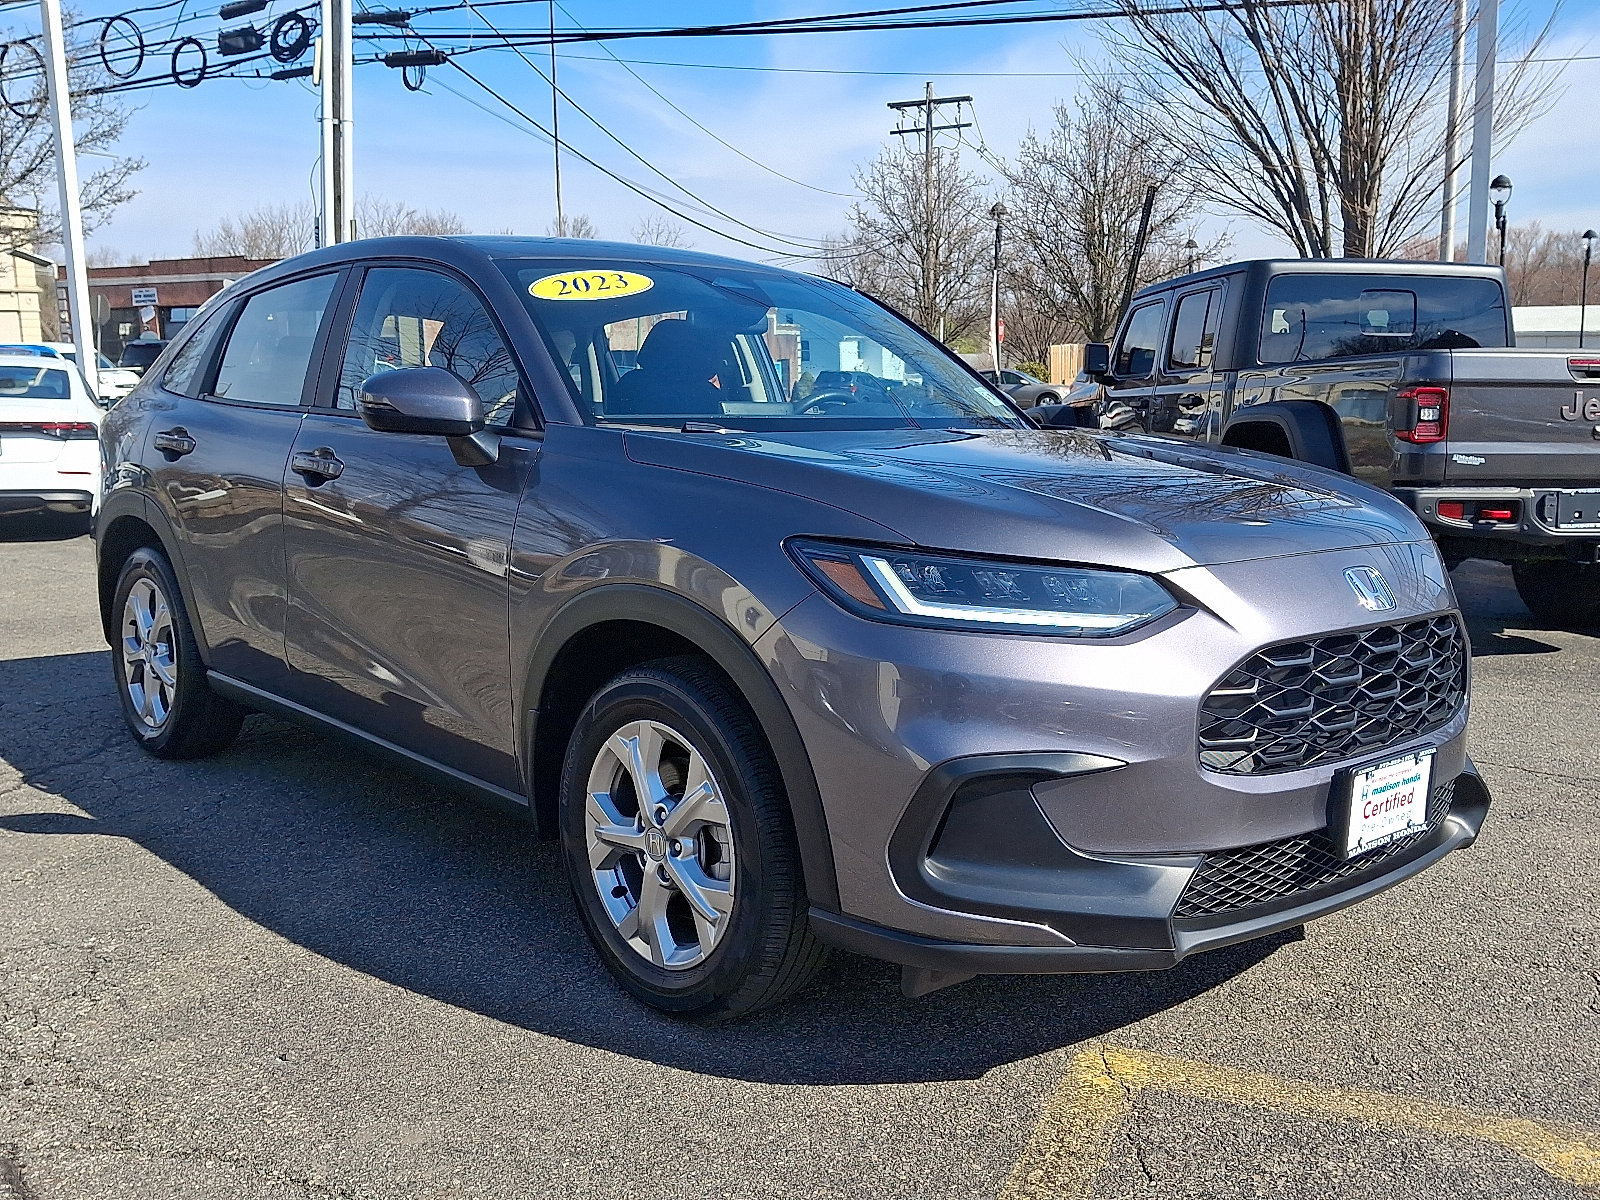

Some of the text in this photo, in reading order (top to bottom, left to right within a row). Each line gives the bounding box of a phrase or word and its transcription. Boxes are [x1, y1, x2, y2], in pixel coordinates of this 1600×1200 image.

[551, 273, 628, 296] 2023
[1561, 390, 1600, 421] Je
[1371, 781, 1401, 796] madison
[1401, 773, 1421, 786] honda
[1363, 787, 1415, 819] Certified
[1348, 823, 1428, 858] MADISON HONDA
